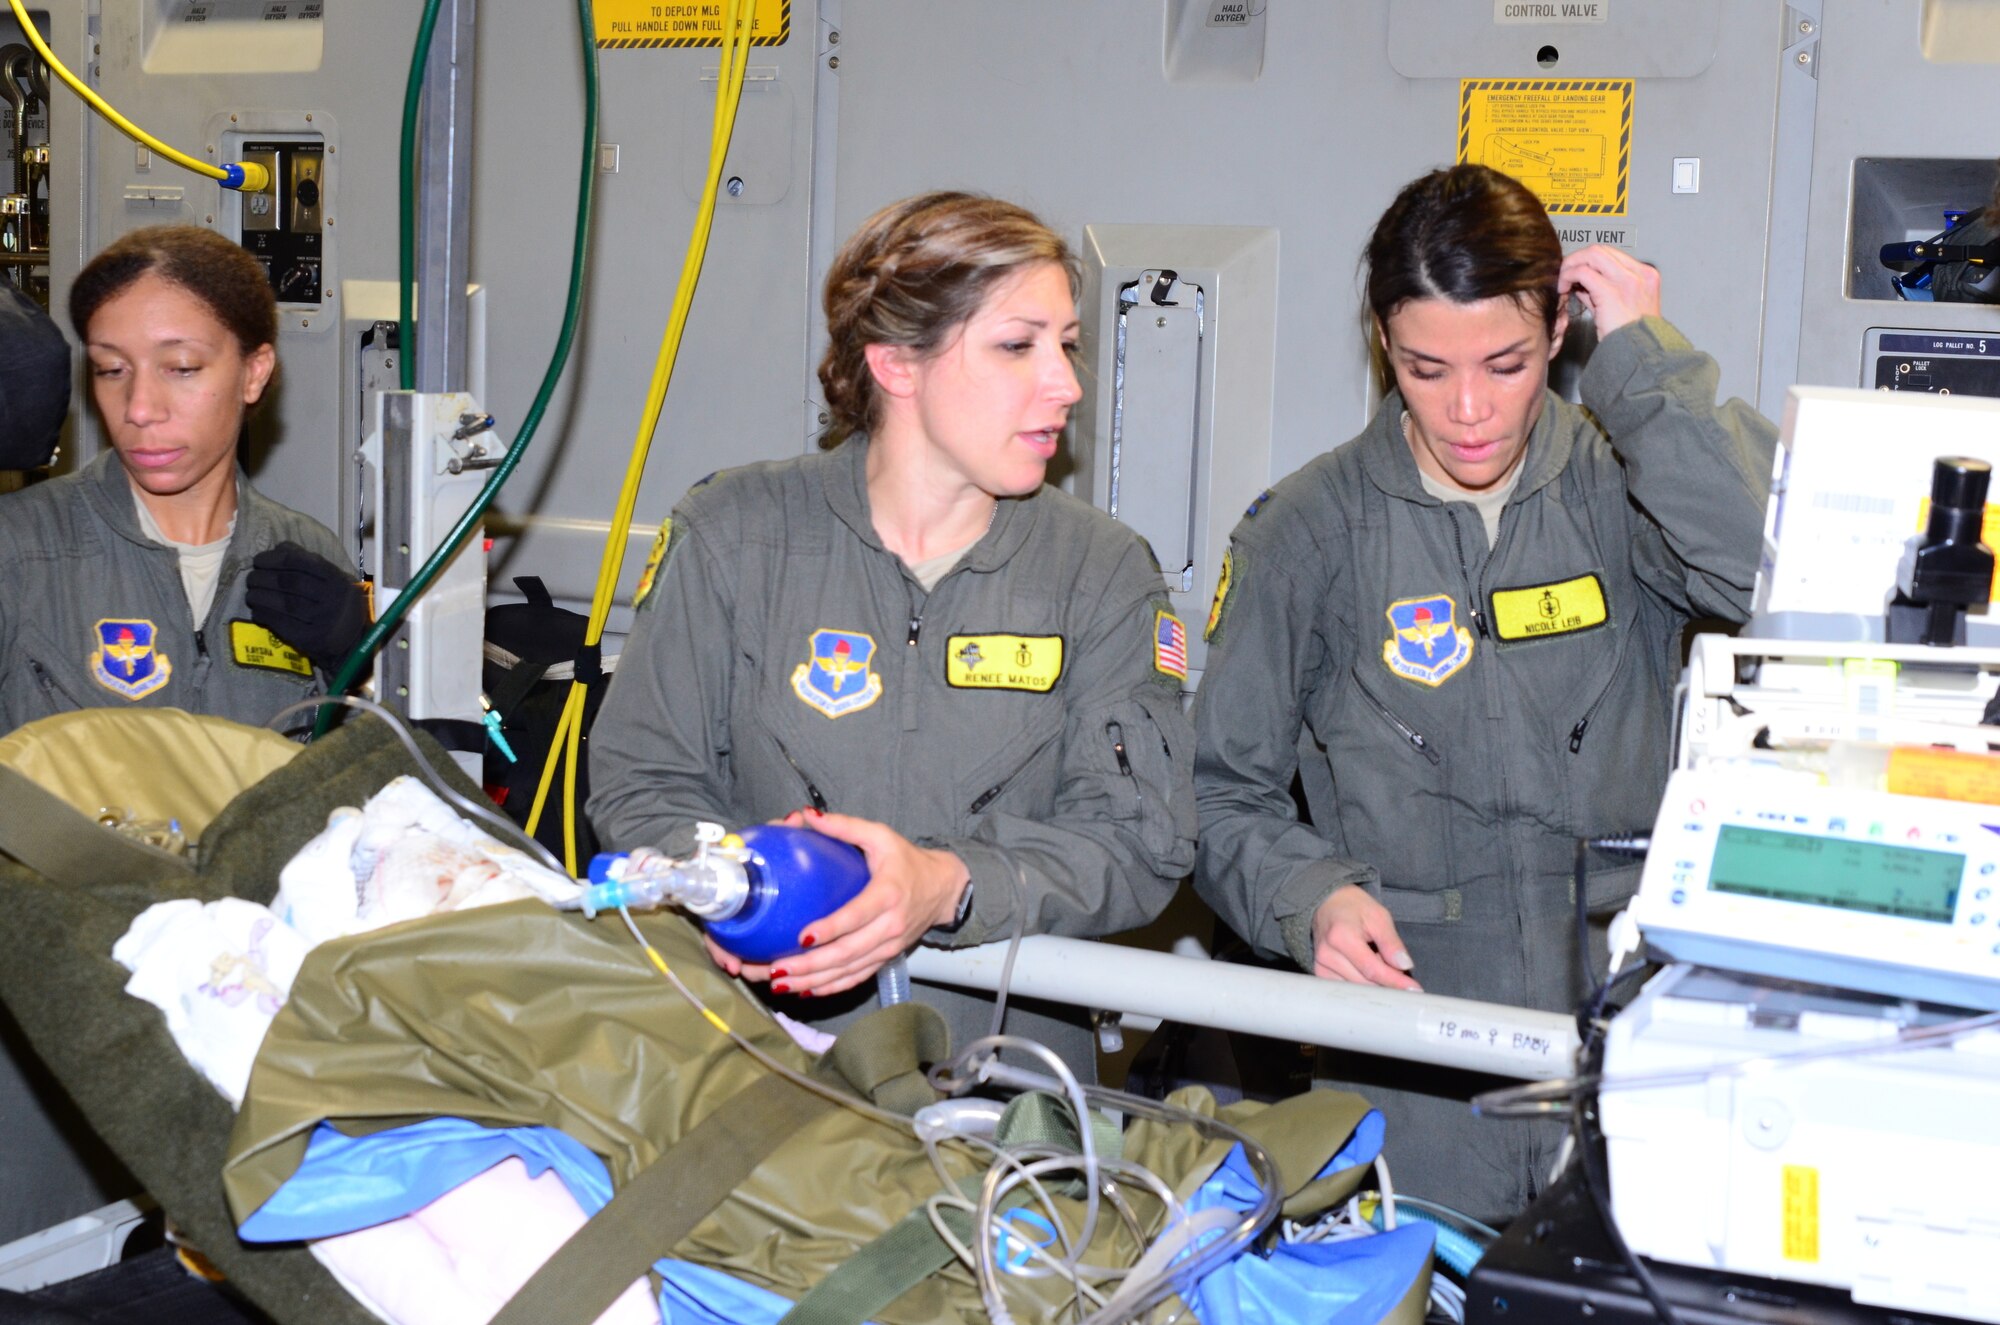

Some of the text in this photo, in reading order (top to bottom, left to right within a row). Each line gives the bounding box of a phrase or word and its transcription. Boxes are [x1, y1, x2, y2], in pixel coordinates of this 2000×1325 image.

[651, 5, 720, 17] TO DEPLOY MLG
[1504, 4, 1598, 17] CONTROL VALVE
[1214, 14, 1246, 22] OXYGEN
[612, 20, 722, 32] PULL HANDLE DOWN FULL
[1596, 230, 1625, 243] VENT
[1979, 340, 1986, 353] 5
[1525, 616, 1582, 633] NICOLE LEIB
[965, 673, 1047, 686] RENEE MATOS
[1440, 1021, 1456, 1038] 18
[1512, 1032, 1550, 1055] BABY
